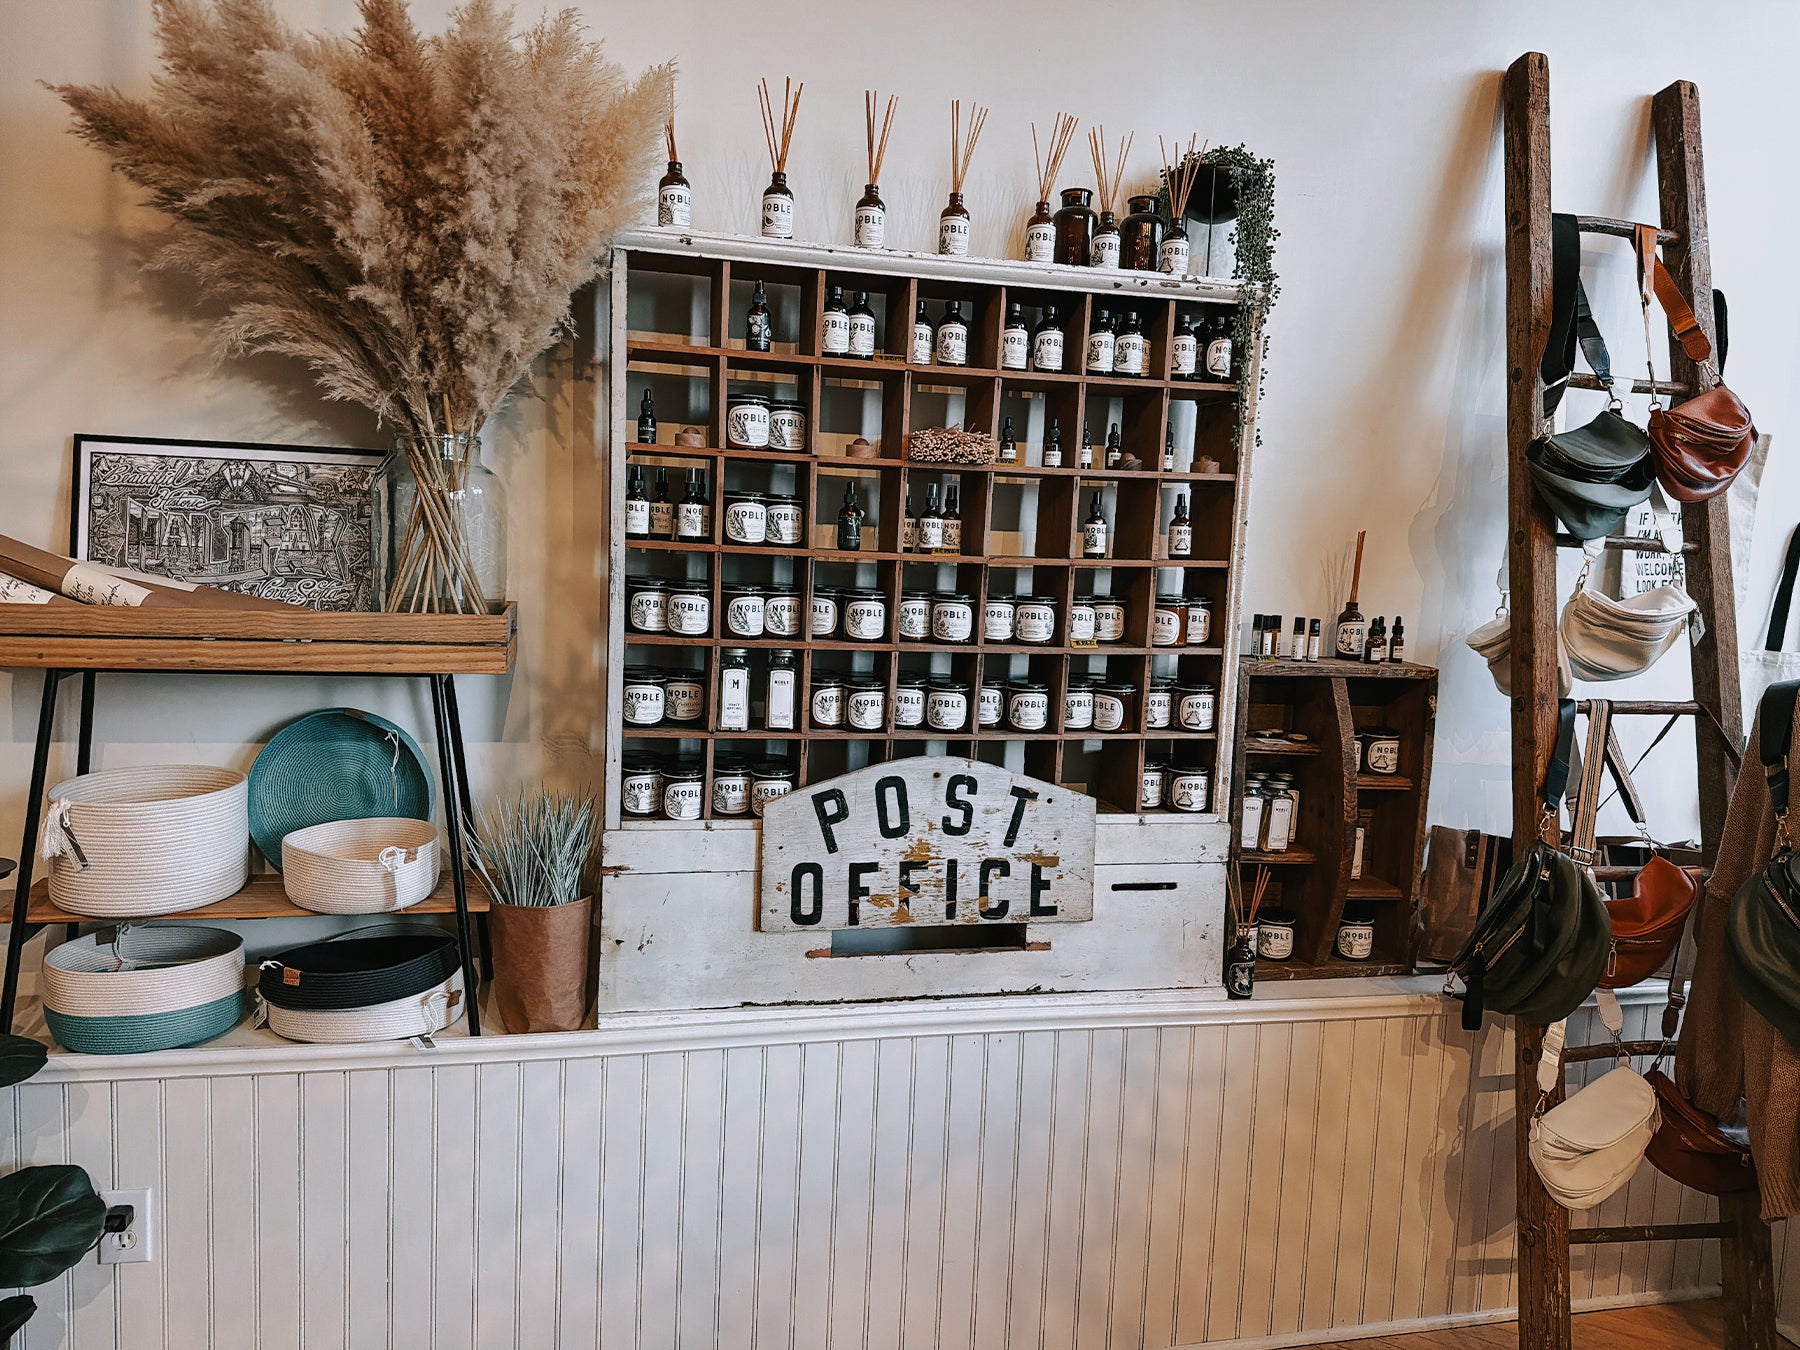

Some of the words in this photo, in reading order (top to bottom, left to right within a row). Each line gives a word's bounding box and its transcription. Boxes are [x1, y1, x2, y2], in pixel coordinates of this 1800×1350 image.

[824, 319, 847, 330] OBLE
[913, 331, 932, 343] OBLE
[1004, 337, 1026, 347] NOBL
[1040, 338, 1062, 348] NOBL
[1091, 340, 1113, 349] NOBL
[1174, 344, 1196, 352] OBLE
[1215, 346, 1231, 355] NOB
[735, 413, 767, 424] NOBLE
[772, 418, 803, 428] NOBLE
[626, 504, 645, 512] BLE
[651, 505, 670, 513] OBLE
[686, 508, 702, 516] NOB
[733, 510, 764, 520] NOBLE
[770, 513, 800, 521] NOBLE
[1639, 512, 1649, 526] IF
[944, 522, 960, 530] NOB
[637, 599, 664, 608] NOBL
[673, 602, 706, 612] NOBLE
[813, 605, 830, 614] BLE
[852, 608, 882, 617] NOBLE
[937, 610, 967, 619] NOBLE
[1019, 612, 1048, 620] NOBLE
[1072, 613, 1093, 622] OBLE
[1189, 615, 1207, 623] BLE
[1155, 616, 1173, 625] BLE
[1342, 628, 1363, 636] NOBL
[627, 692, 660, 701] NOBLE
[668, 689, 699, 698] NOBLE
[821, 695, 840, 703] NOB
[897, 696, 921, 704] OBLE
[932, 698, 962, 708] NOBLE
[980, 695, 997, 704] BLE
[1018, 700, 1045, 708] NOBLE
[1095, 701, 1115, 711] BLE
[1377, 746, 1397, 754] NOBL
[717, 783, 748, 792] NOBLE
[1144, 779, 1161, 787] OBL
[757, 787, 788, 796] NOBLE
[811, 774, 1039, 854] POST
[790, 858, 1058, 926] OFFICE
[1262, 930, 1290, 940] NOBLE
